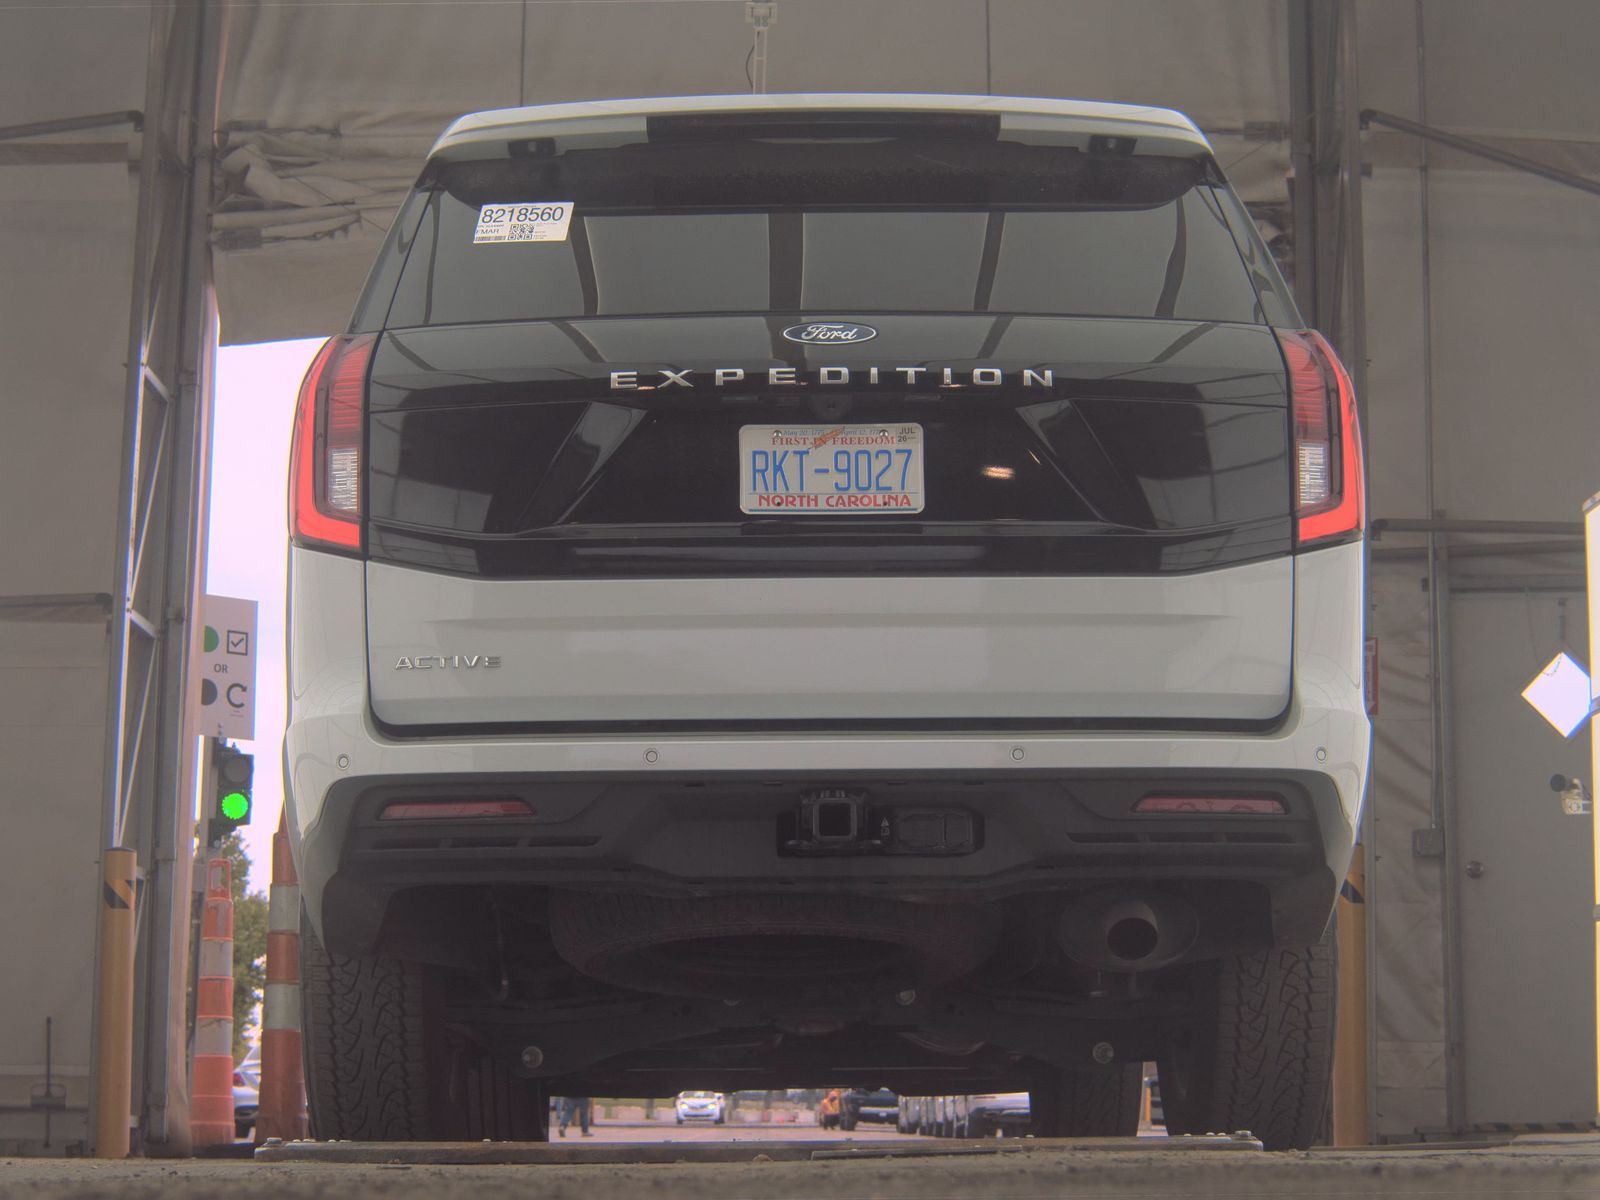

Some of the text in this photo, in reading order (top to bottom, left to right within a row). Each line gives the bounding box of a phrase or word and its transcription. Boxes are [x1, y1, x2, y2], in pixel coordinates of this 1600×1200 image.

[481, 206, 564, 224] 8218560
[801, 323, 858, 342] Ford
[610, 366, 1054, 390] EXPEDITION
[899, 426, 916, 435] JUL
[771, 436, 809, 446] FIRST
[832, 435, 896, 446] FREEDOM
[897, 435, 908, 443] 26
[751, 448, 914, 492] RKT-9027
[758, 494, 912, 508] NORTH CAROLINA
[213, 663, 229, 674] OR
[395, 655, 502, 670] ACTIVE
